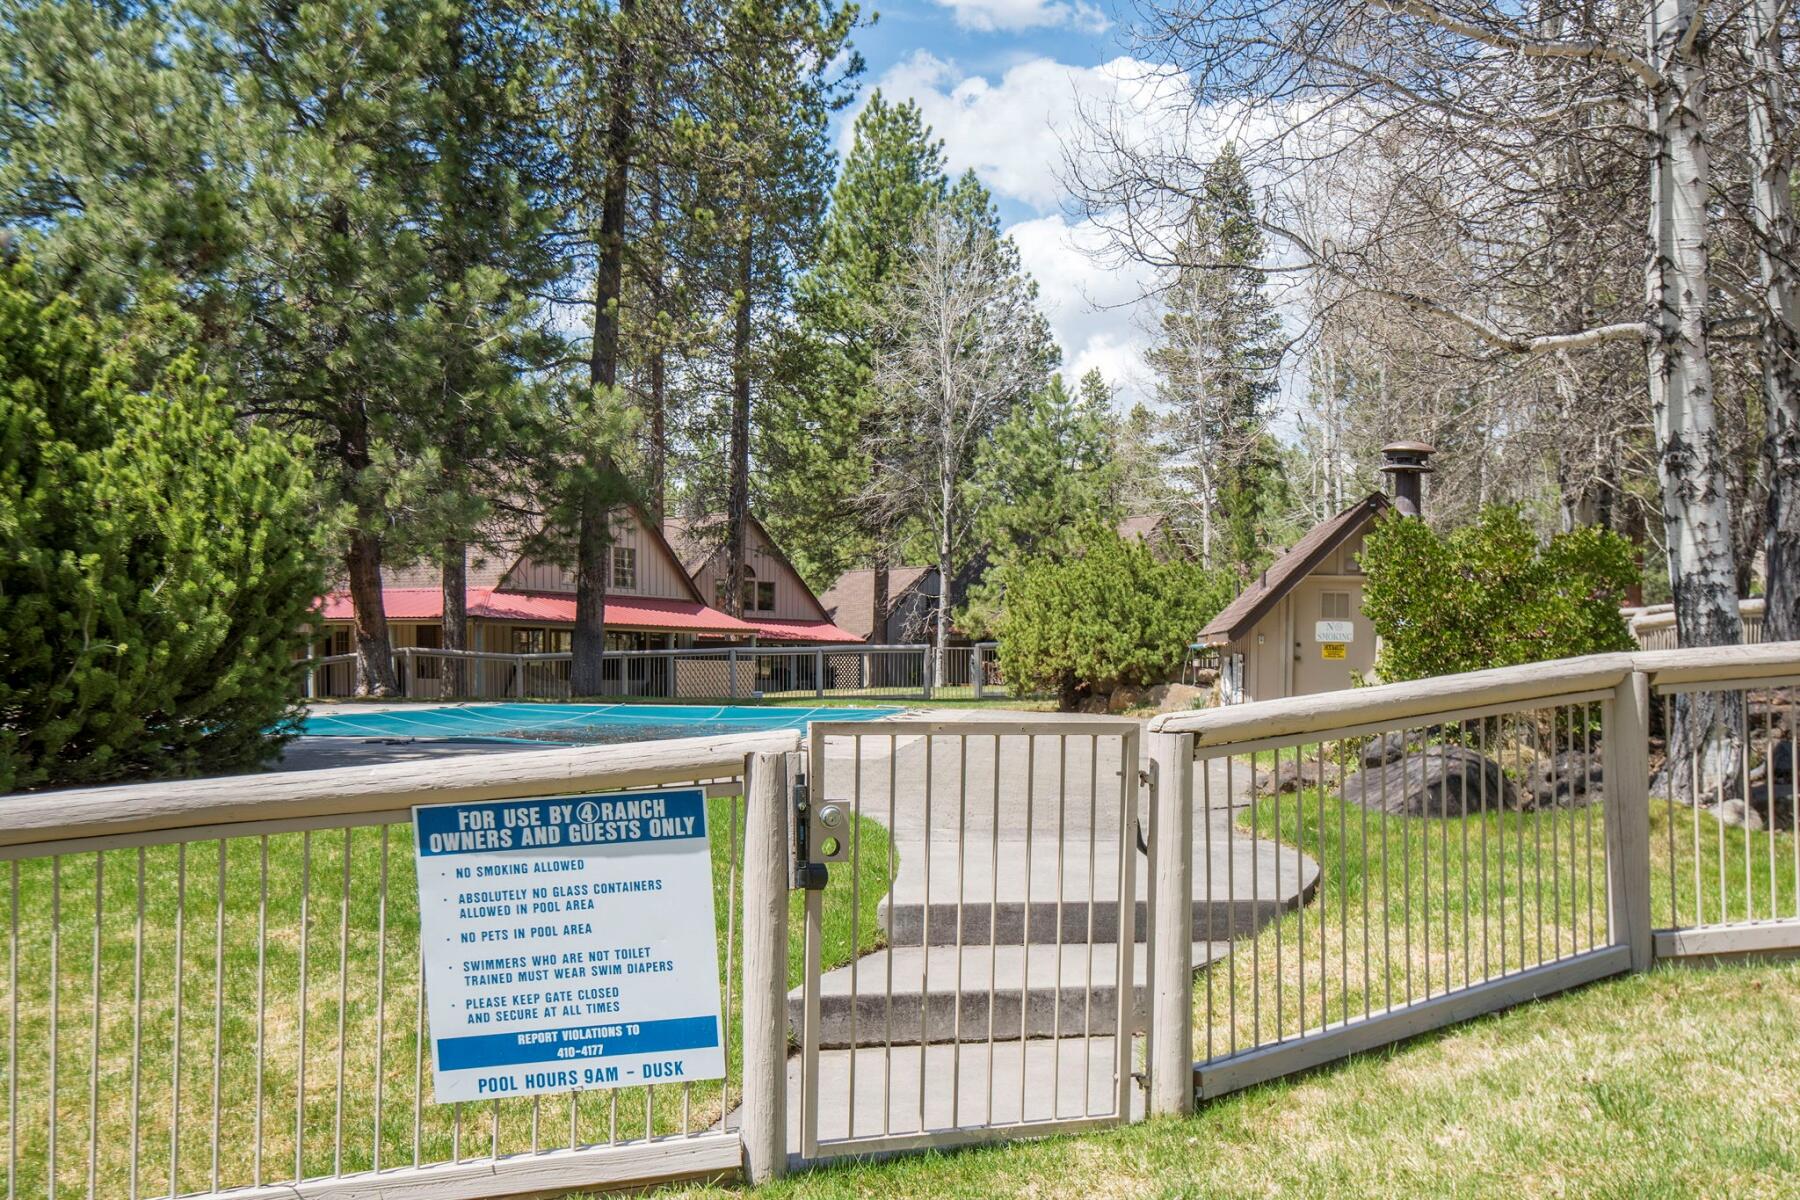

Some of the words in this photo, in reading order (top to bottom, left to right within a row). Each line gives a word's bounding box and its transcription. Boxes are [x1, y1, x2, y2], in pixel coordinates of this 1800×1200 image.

[1317, 631, 1352, 640] SMOKING
[458, 810, 496, 830] FOR
[504, 807, 540, 827] USE
[550, 805, 572, 824] BY
[578, 804, 595, 822] 4
[602, 799, 665, 821] RANCH
[430, 828, 512, 853] OWNERS
[521, 826, 560, 846] AND
[569, 821, 642, 843] GUESTS
[650, 816, 695, 837] ONLY
[456, 867, 471, 878] NO
[477, 863, 528, 877] SMOKING
[534, 859, 584, 873] ALLOWED
[458, 889, 527, 904] ABSOLUTELY
[533, 887, 547, 899] NO
[553, 885, 588, 897] GLASS
[593, 879, 662, 894] CONTAINERS
[459, 905, 511, 919] ALLOWED
[517, 904, 528, 915] IN
[533, 902, 560, 913] POOL
[565, 900, 594, 911] AREA
[460, 932, 476, 943] NO
[481, 929, 508, 941] PETS
[514, 928, 525, 939] IN
[531, 926, 558, 938] POOL
[563, 923, 592, 935] AREA
[463, 957, 526, 972] SWIMMERS
[532, 954, 557, 967] WHO
[562, 952, 583, 964] ARE
[588, 950, 610, 962] NOT
[614, 947, 651, 960] TOILET
[464, 973, 512, 987] TRAINED
[518, 970, 549, 982] MUST
[554, 967, 586, 979] WEAR
[591, 964, 622, 976] SWIM
[627, 960, 674, 974] DIAPERS
[466, 996, 507, 1009] PLEASE
[512, 993, 540, 1006] KEEP
[545, 991, 572, 1003] GATE
[578, 987, 619, 1000] CLOSED
[467, 1013, 490, 1024] AND
[496, 1008, 538, 1022] SECURE
[544, 1007, 557, 1018] AT
[562, 1004, 581, 1016] ALL
[586, 1001, 620, 1014] TIMES
[518, 1032, 558, 1045] REPORT
[562, 1026, 622, 1042] VIOLATIONS
[626, 1024, 640, 1036] TO
[557, 1044, 604, 1058] 410-4177
[478, 1076, 518, 1093] POOL
[525, 1071, 578, 1089] HOURS
[584, 1066, 618, 1084] 9AM
[643, 1061, 684, 1078] DUSK
